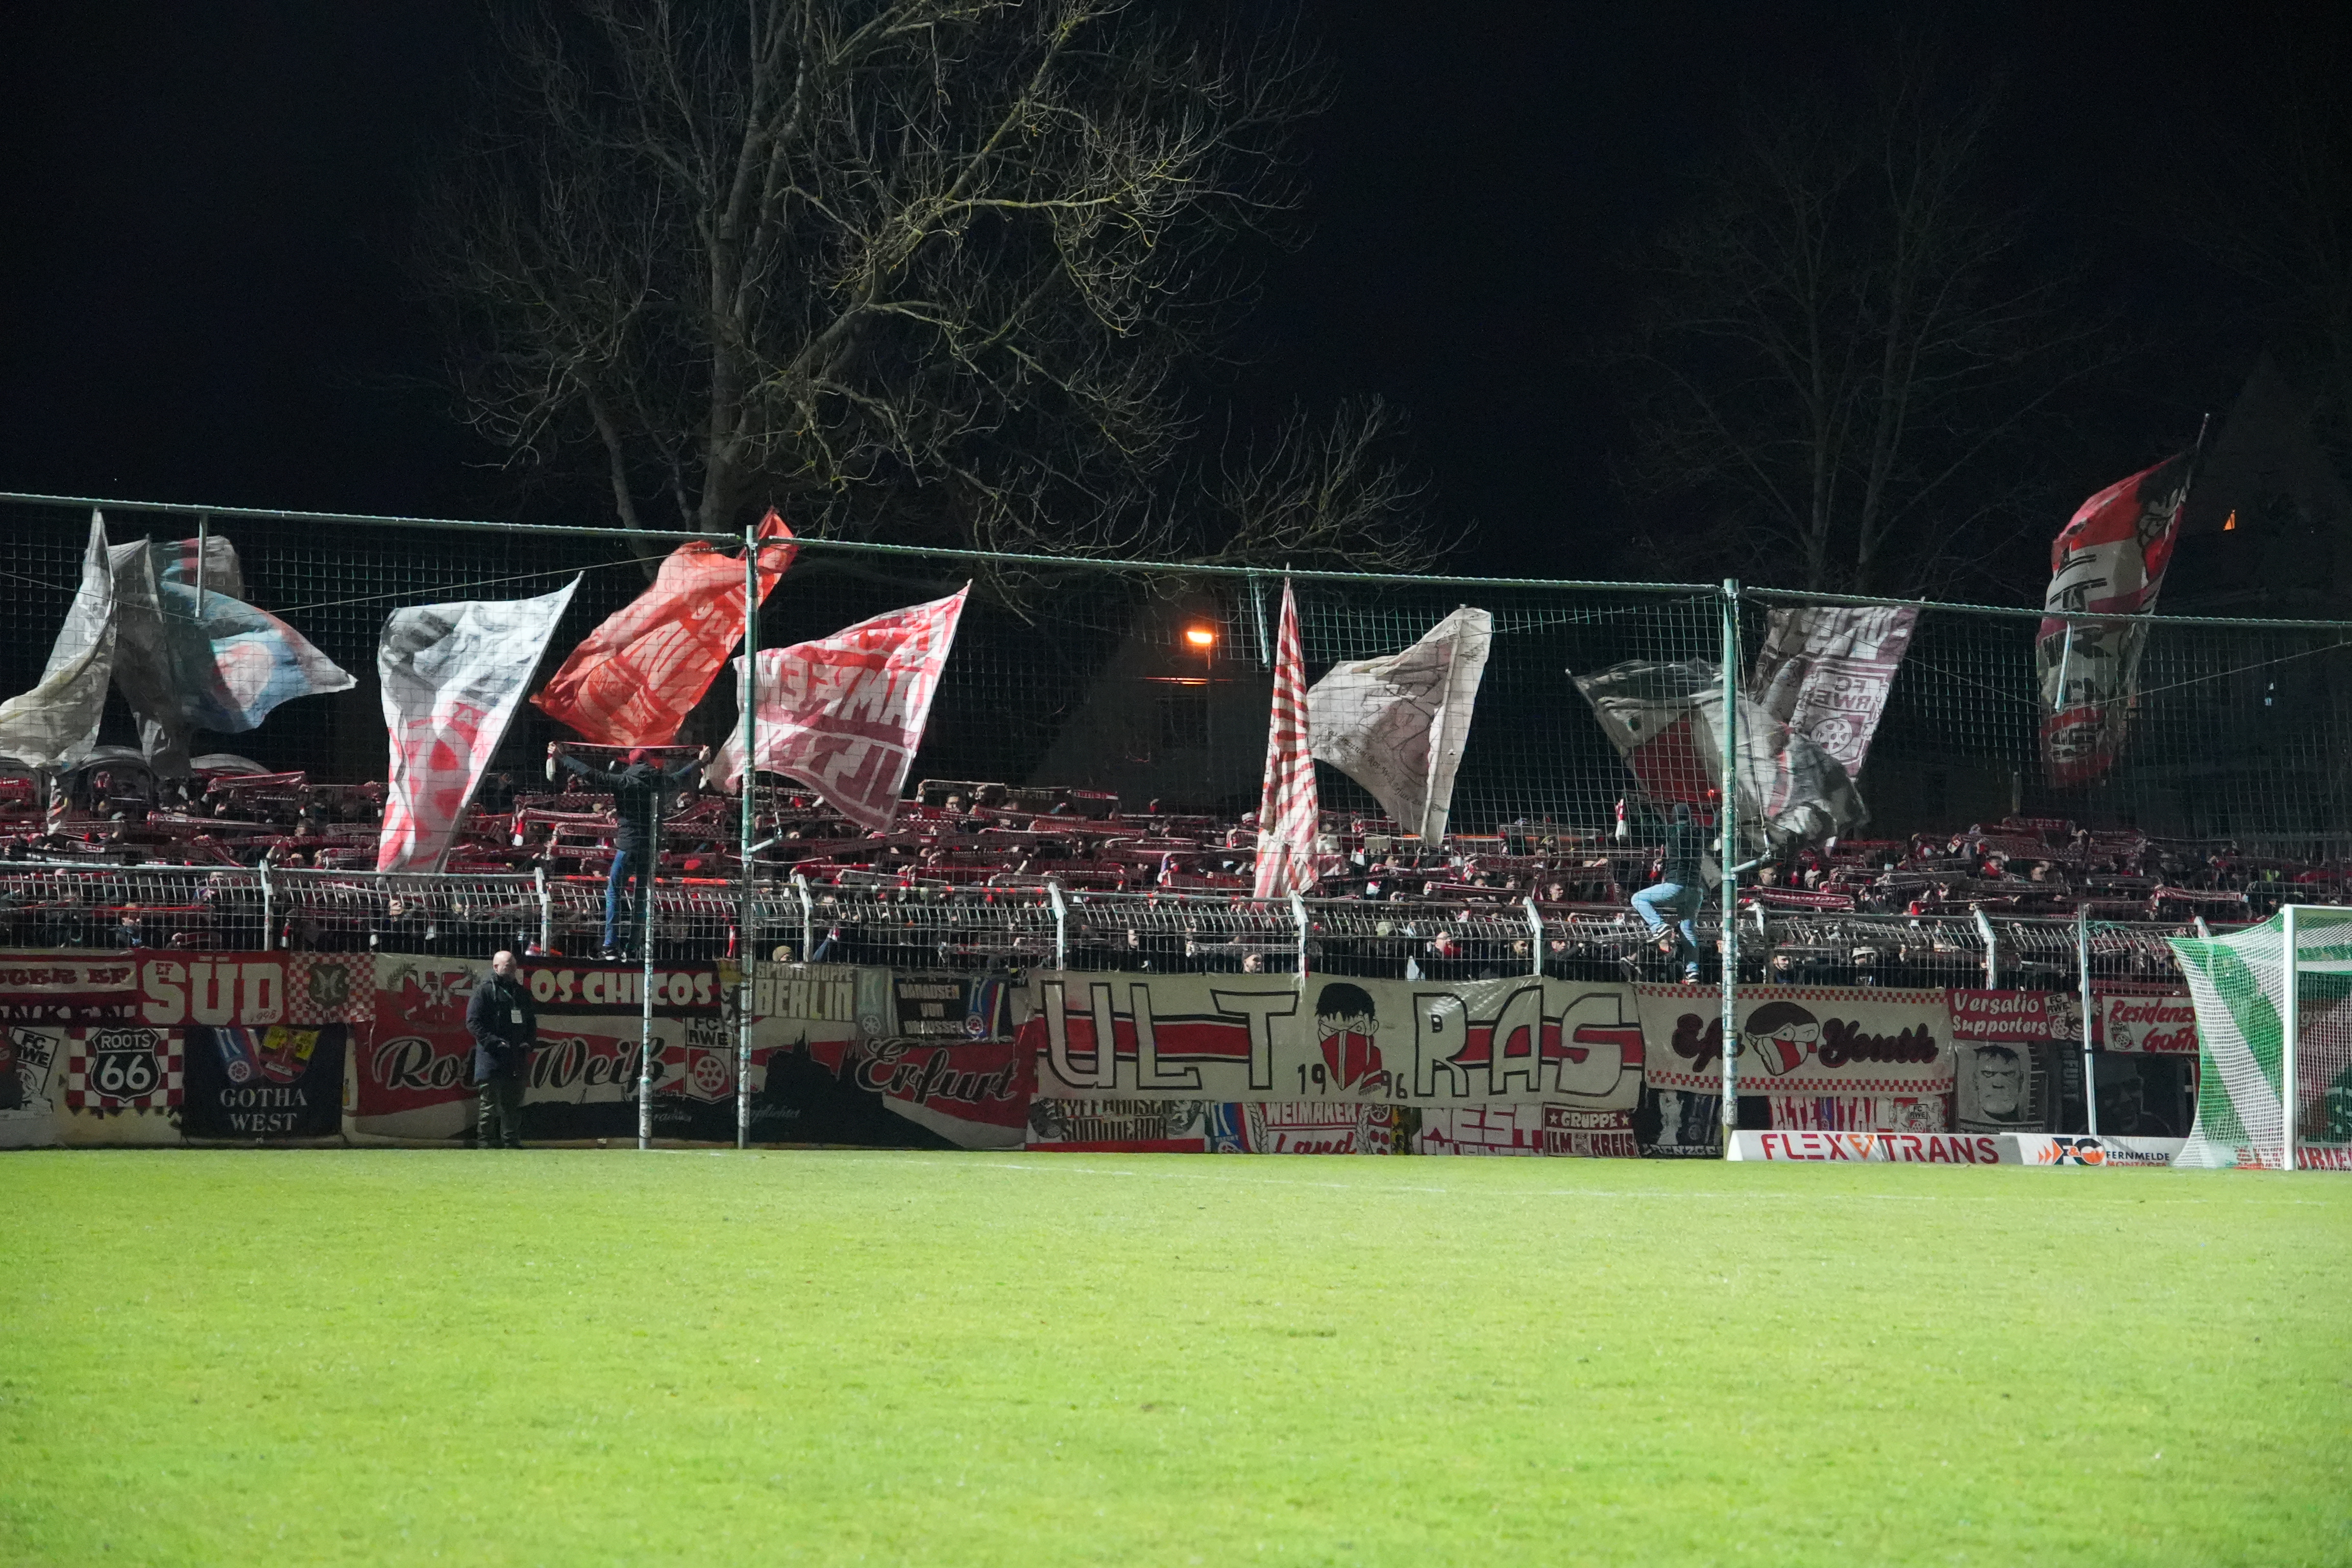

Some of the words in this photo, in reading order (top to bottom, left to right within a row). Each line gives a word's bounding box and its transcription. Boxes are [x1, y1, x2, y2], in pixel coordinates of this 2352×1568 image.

[142, 955, 283, 1026] SÜD
[582, 971, 713, 1006] CHICOS
[754, 978, 853, 1020] BERLIN
[1953, 1015, 2048, 1036] Supporters
[101, 1034, 151, 1048] ROOTS
[101, 1054, 151, 1091] 66
[854, 1037, 1019, 1107] Erfurt
[220, 1088, 307, 1107] GOTHA
[230, 1113, 298, 1132] WEST
[1561, 1112, 1618, 1128] GRUPPE
[1274, 1131, 1357, 1155] Land
[1591, 1134, 1635, 1156] KREIS
[1761, 1134, 1849, 1160] FLEX
[1877, 1135, 2000, 1164] TRANS
[2106, 1150, 2170, 1161] FERNMELDE
